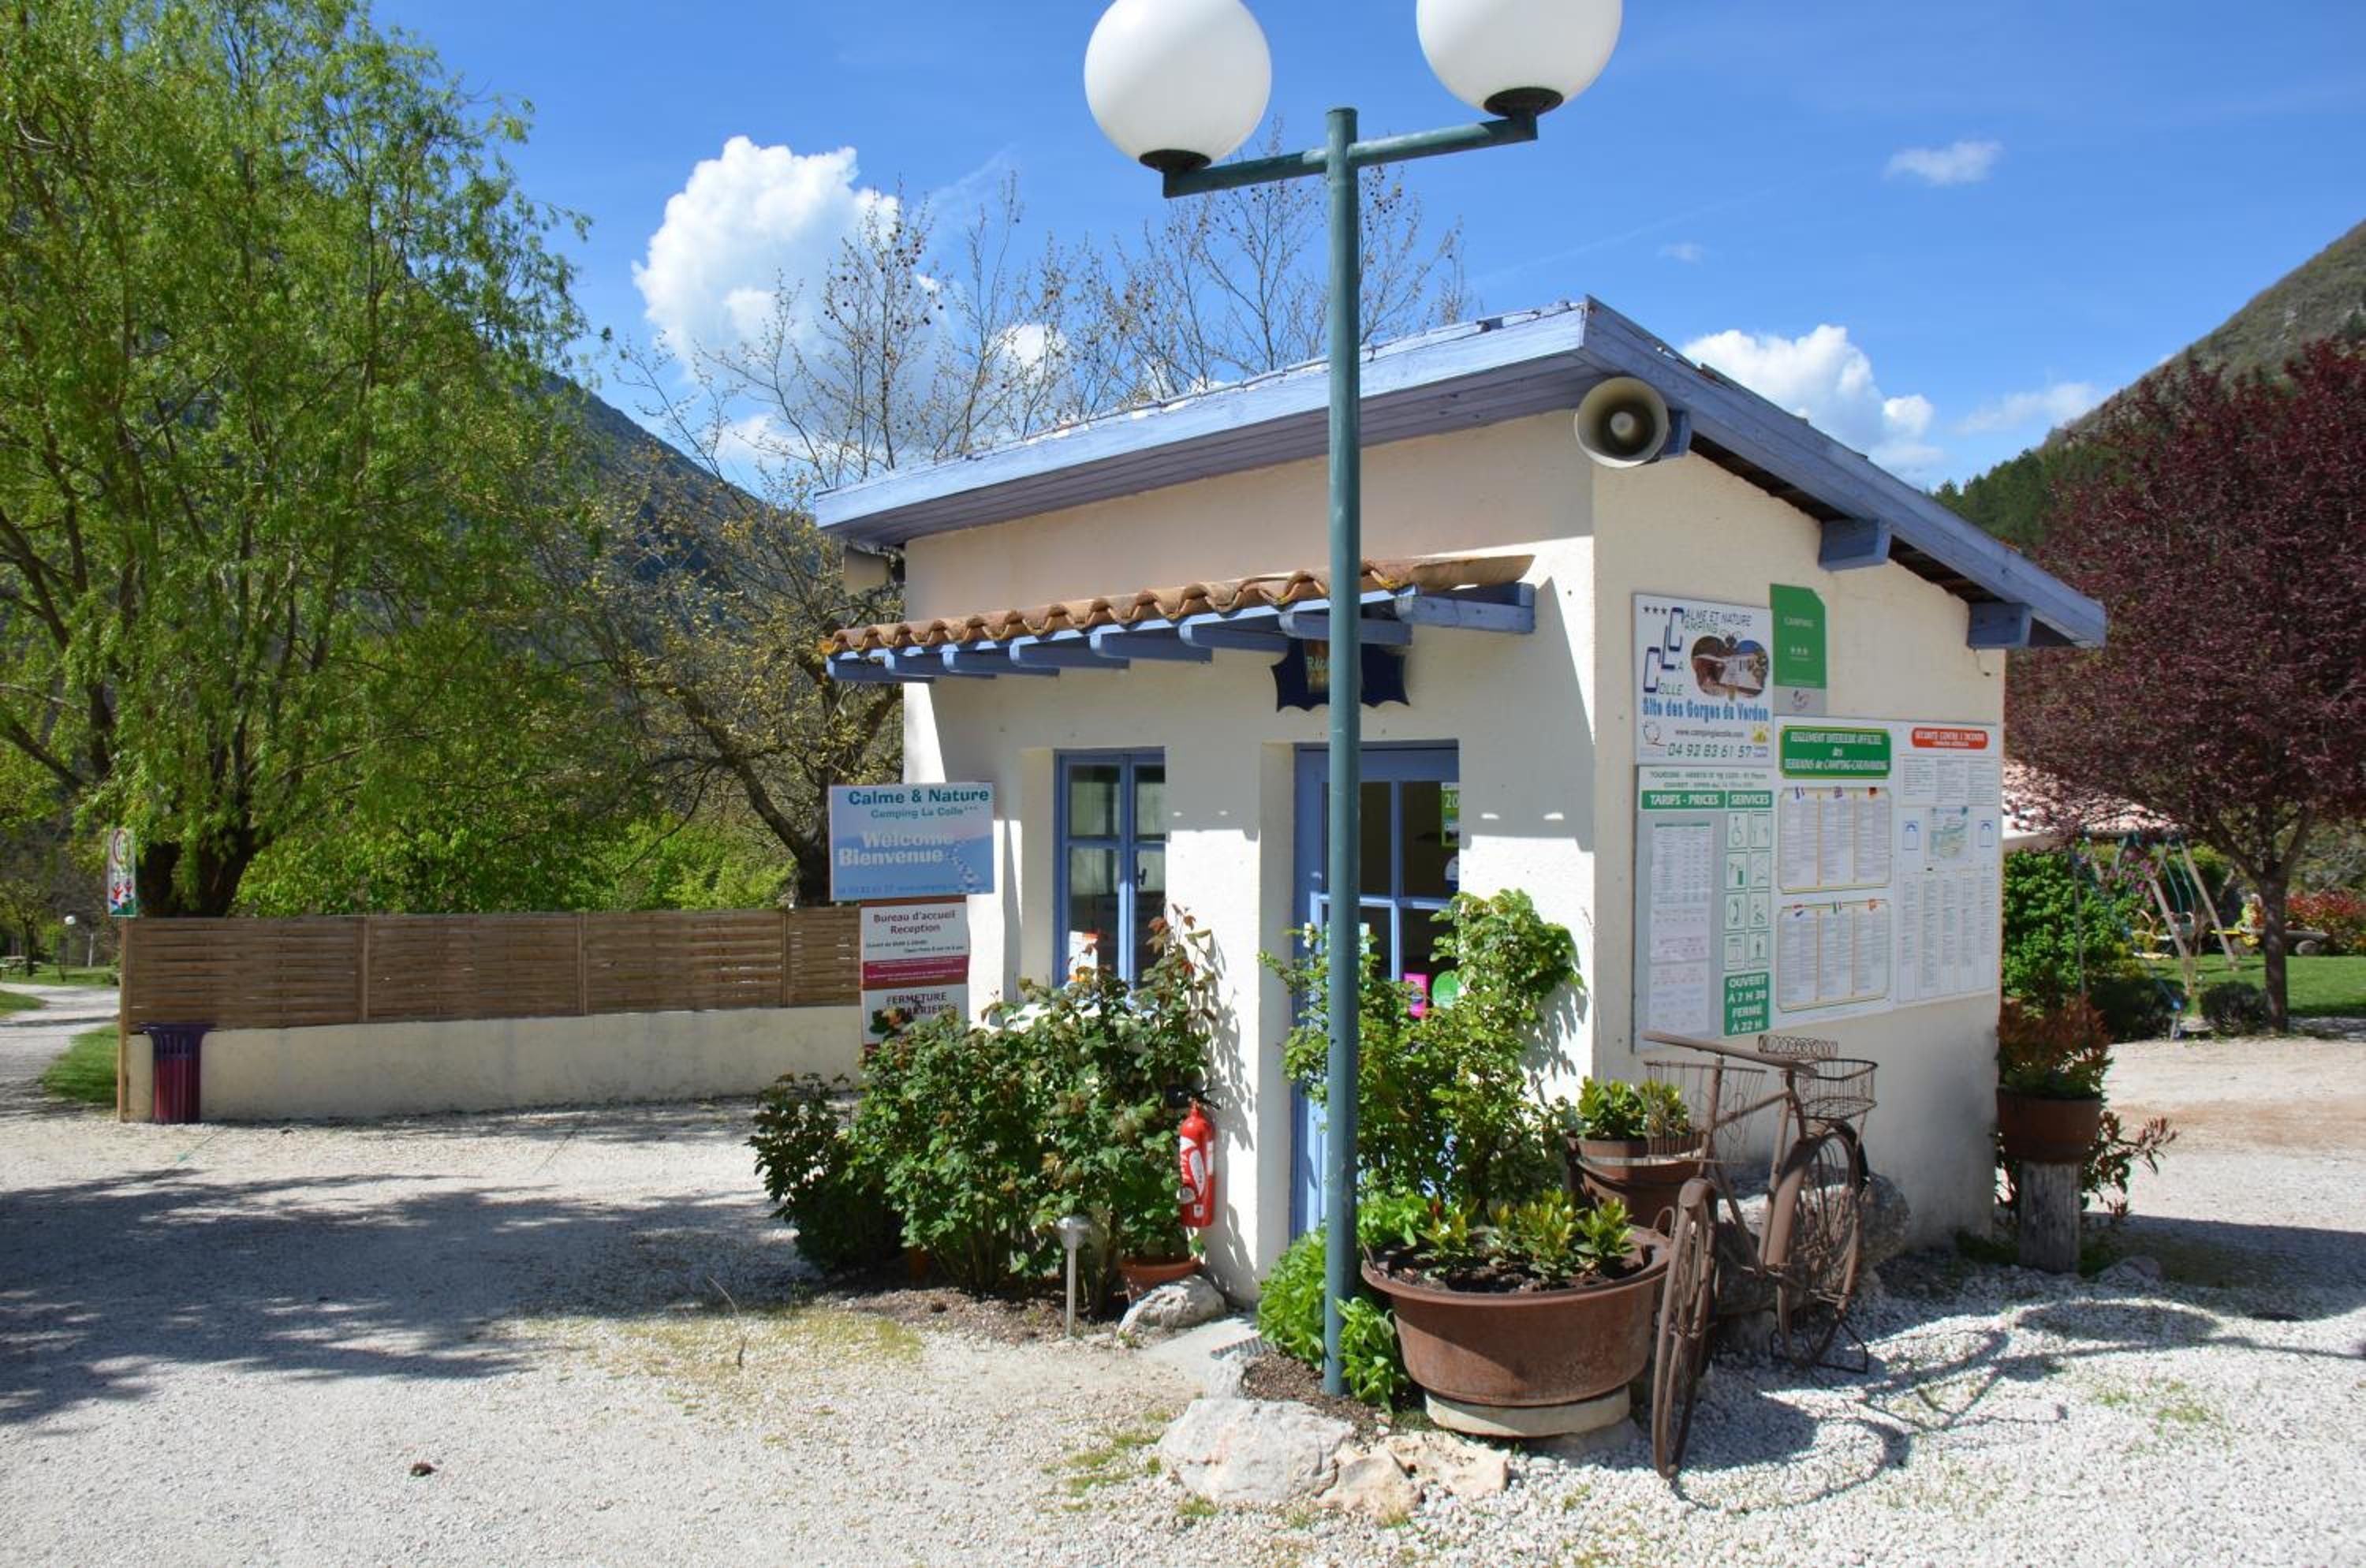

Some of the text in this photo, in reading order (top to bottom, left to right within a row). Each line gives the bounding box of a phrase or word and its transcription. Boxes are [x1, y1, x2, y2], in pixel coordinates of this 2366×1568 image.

[1666, 698, 1684, 717] des
[1687, 699, 1721, 723] Gorges
[1737, 703, 1769, 722] Verdon
[1667, 743, 1683, 757] 04
[1687, 744, 1701, 757] 92
[1738, 745, 1752, 758] 57
[848, 788, 990, 805] Calme & Nature
[1650, 794, 1681, 805] TARIFS
[1689, 794, 1719, 805] PRICES
[1731, 794, 1770, 805] SERVICES
[871, 809, 919, 819] Camping
[921, 808, 935, 816] La
[862, 831, 956, 849] Welcome
[838, 848, 943, 867] Bienvenue
[874, 910, 955, 923] Bureau d'accueil
[890, 924, 941, 934] Reception
[1728, 974, 1765, 987] OUVERT
[886, 991, 947, 1006] FERMETURE
